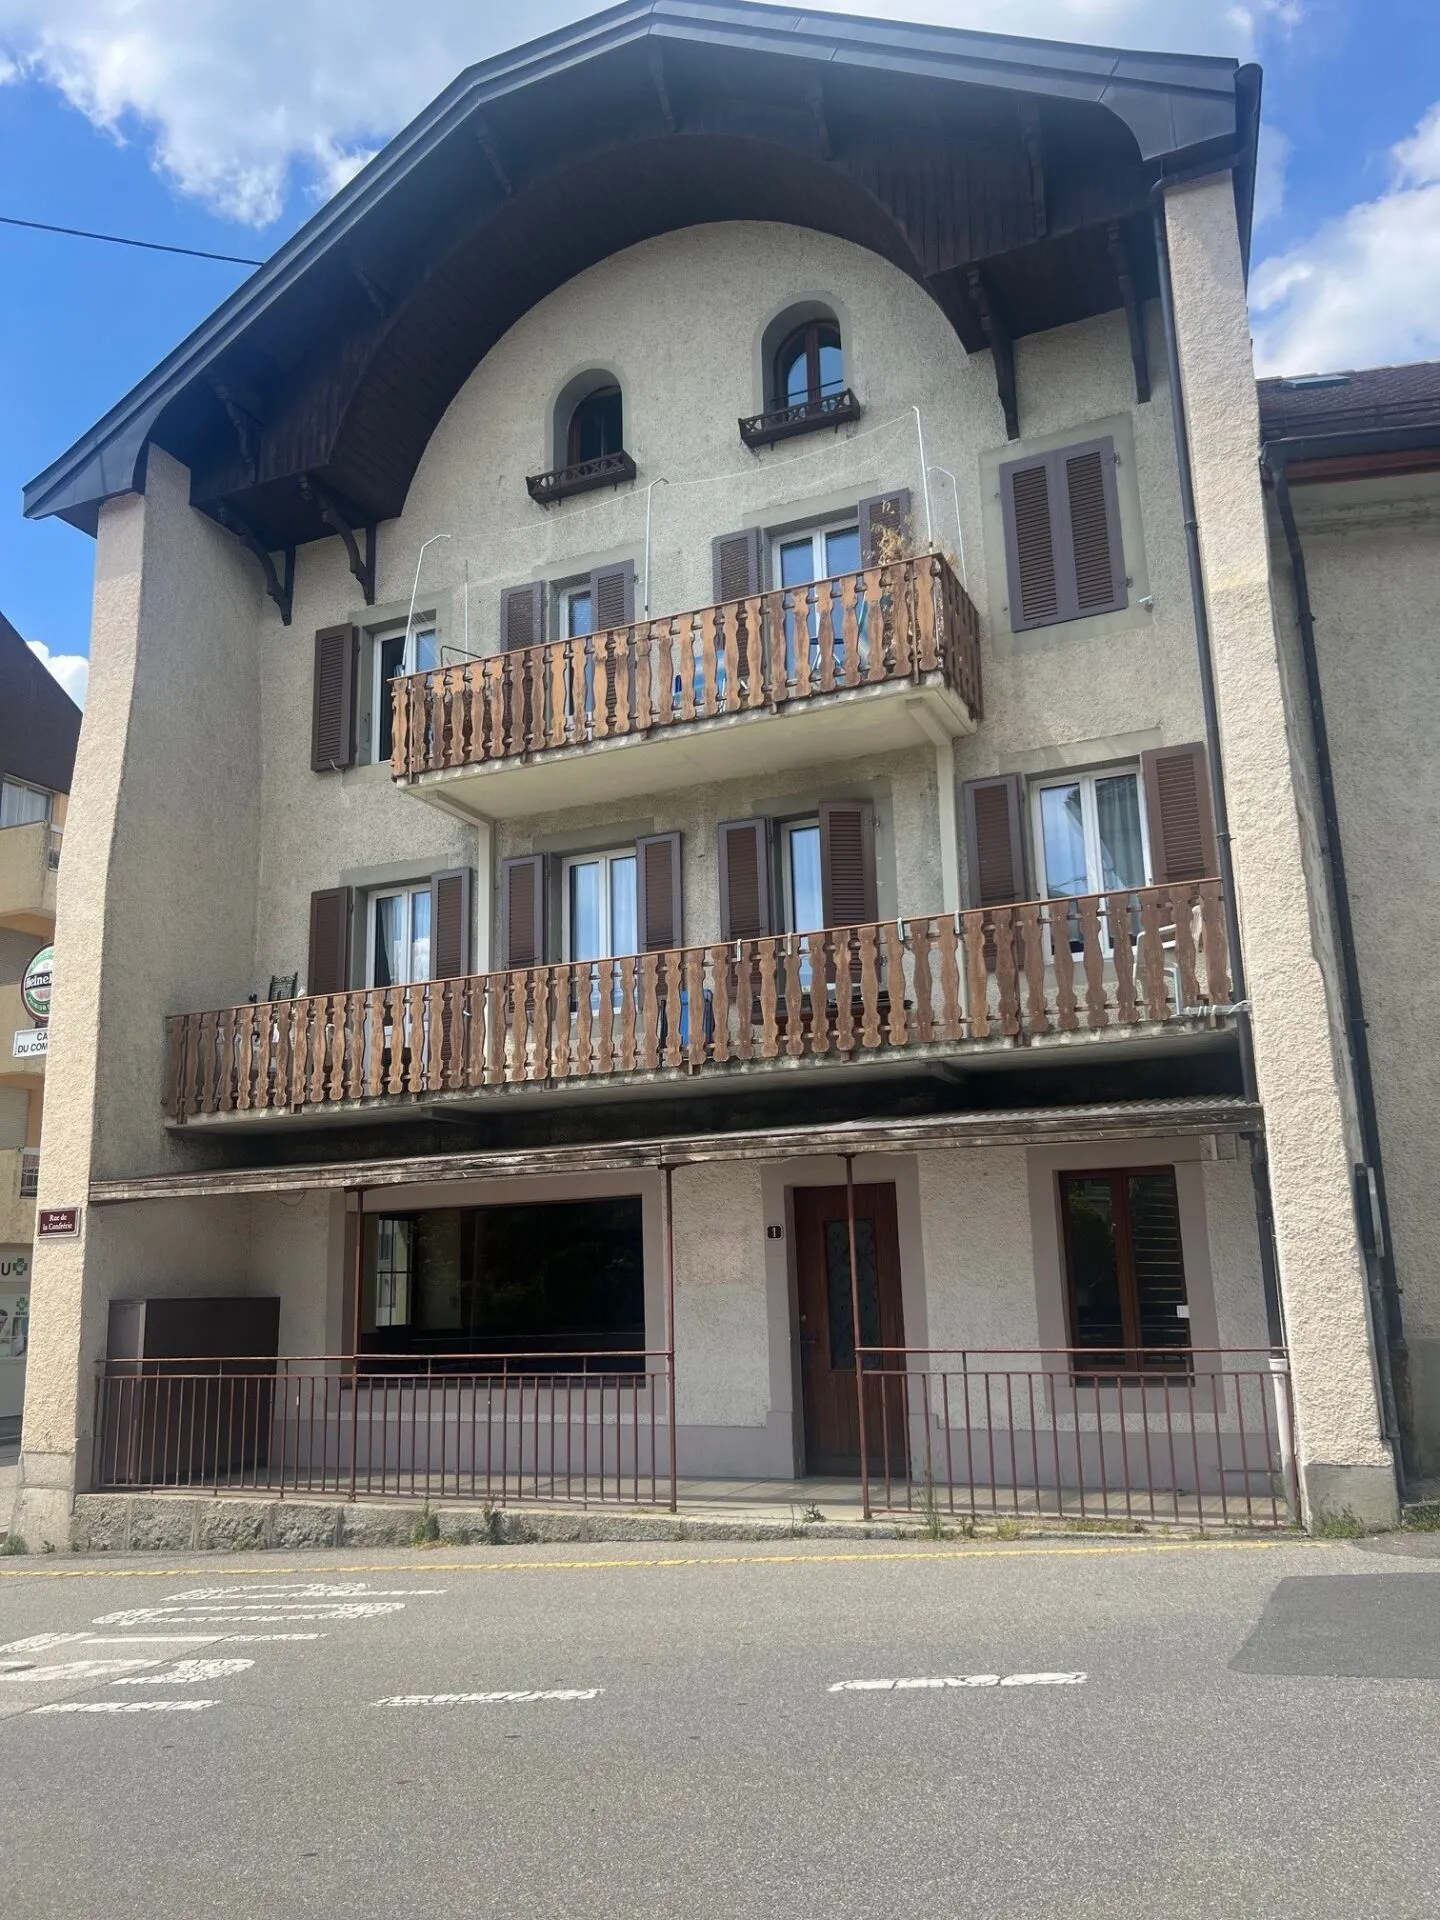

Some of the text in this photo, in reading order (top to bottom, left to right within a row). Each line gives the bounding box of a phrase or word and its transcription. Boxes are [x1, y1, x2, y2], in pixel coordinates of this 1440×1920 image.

[17, 1045, 29, 1053] DU
[49, 1213, 68, 1222] Rue de
[42, 1222, 73, 1231] la Confrérie
[0, 1582, 448, 1684] STOP
